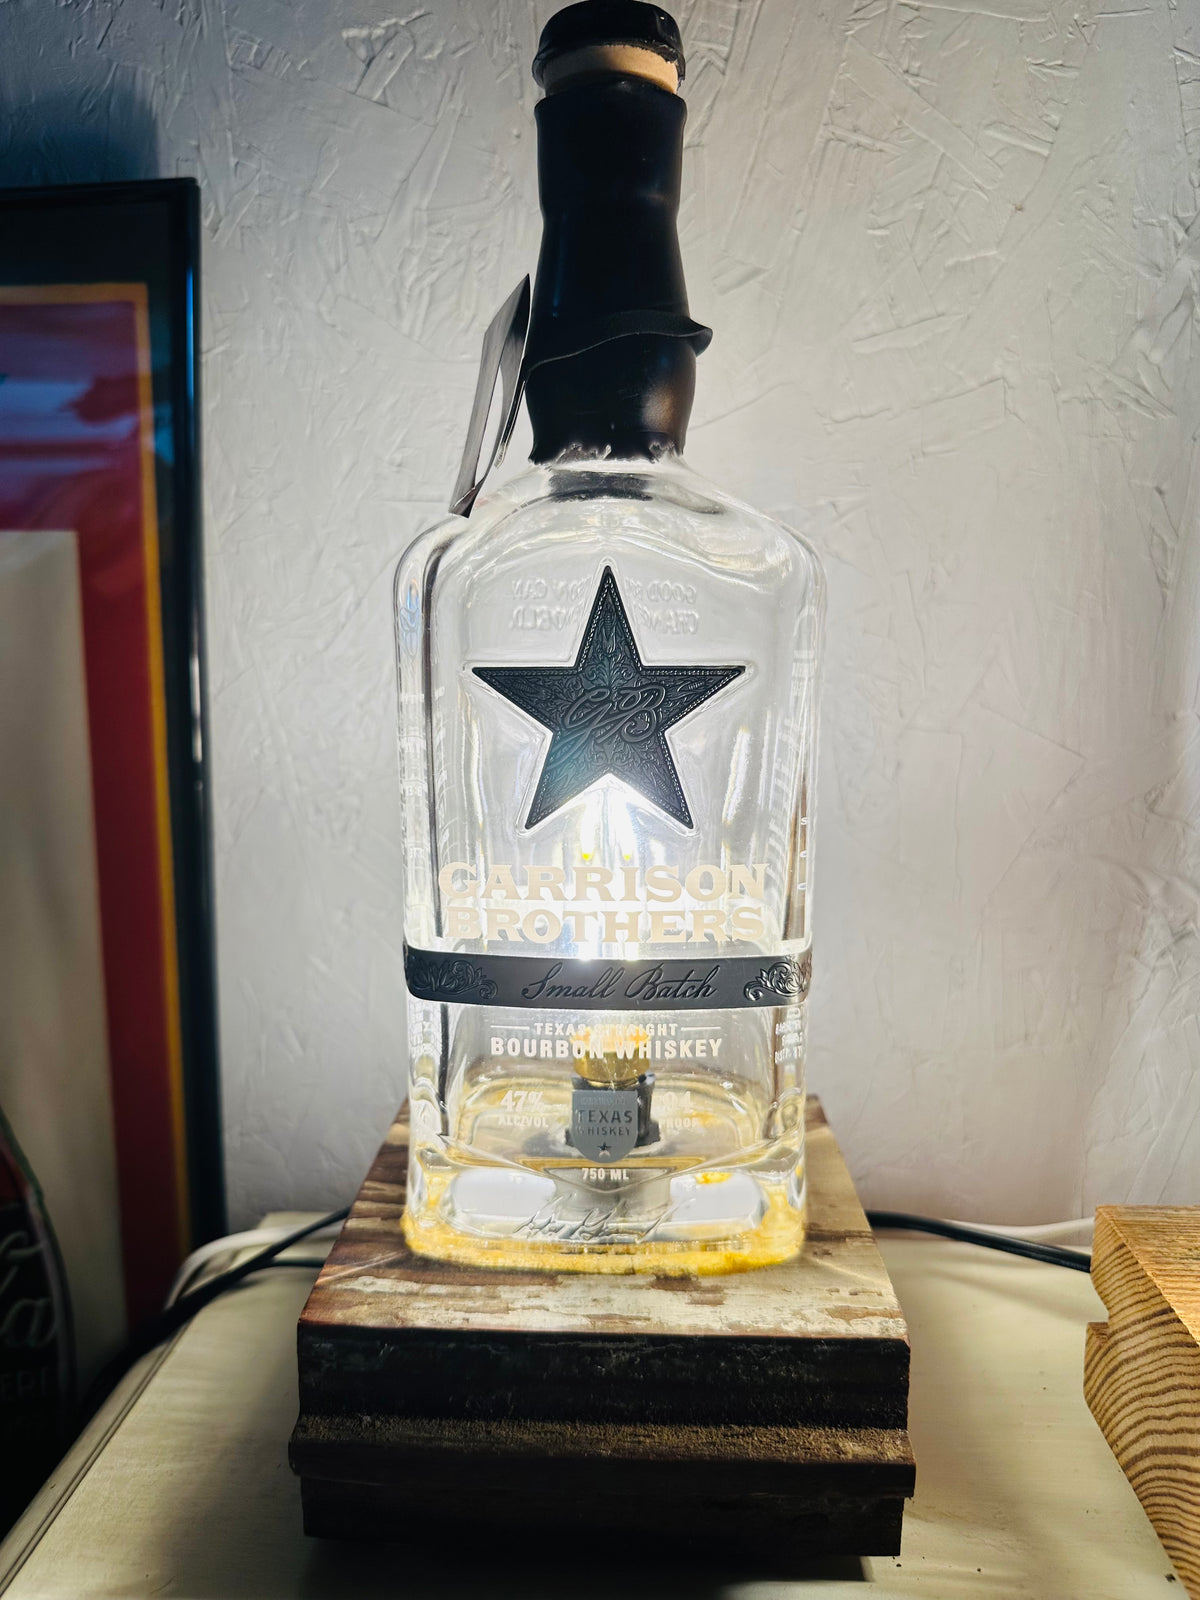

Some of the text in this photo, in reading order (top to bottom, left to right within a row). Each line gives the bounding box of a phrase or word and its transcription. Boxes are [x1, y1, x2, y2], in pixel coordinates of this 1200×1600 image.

[438, 862, 770, 901] GARRISON
[445, 906, 764, 943] BROTHERS
[522, 962, 719, 1000] Small Batch
[534, 1022, 586, 1036] TEXAS
[490, 1036, 722, 1060] BOURBON WHISKEY
[500, 1090, 545, 1112] 47%
[576, 1109, 633, 1123] TEXAS
[581, 1168, 629, 1180] 750 ML
